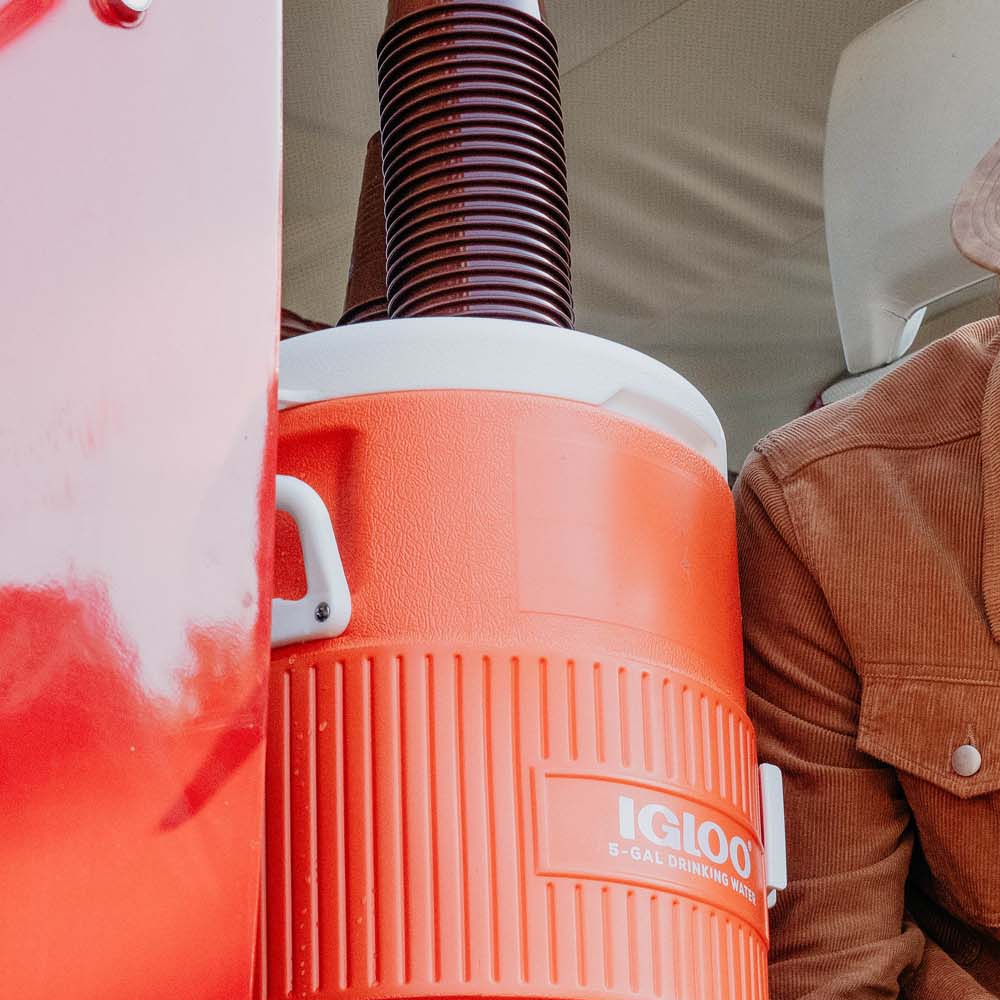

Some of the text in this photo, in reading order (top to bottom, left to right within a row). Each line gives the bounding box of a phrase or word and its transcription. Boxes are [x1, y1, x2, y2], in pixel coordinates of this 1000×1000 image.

[608, 842, 756, 906] 5-GAL DRINKING WATER
[619, 796, 752, 879] IGLOO
